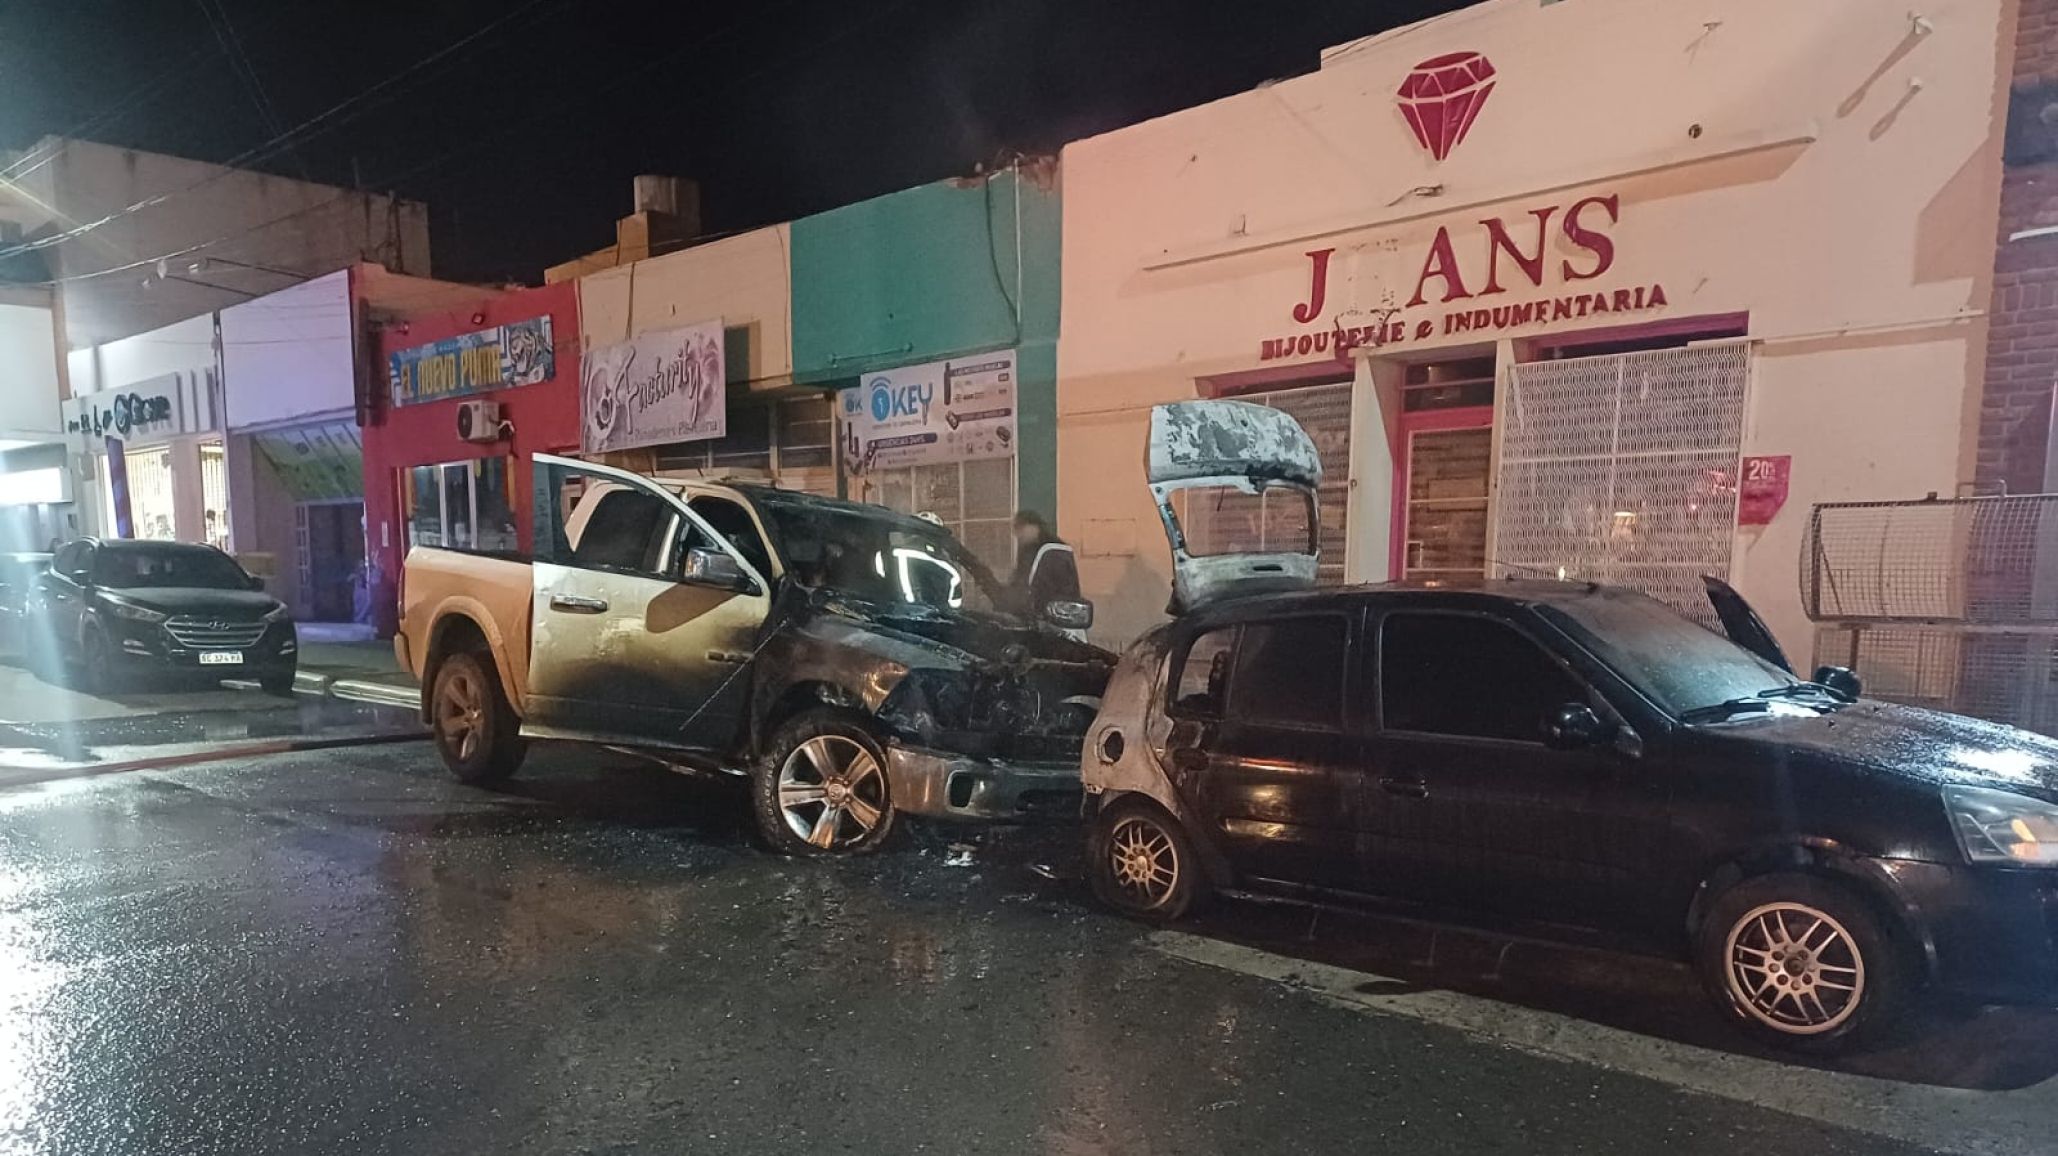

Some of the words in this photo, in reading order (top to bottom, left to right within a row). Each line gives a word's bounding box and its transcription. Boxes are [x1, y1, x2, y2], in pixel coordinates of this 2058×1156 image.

[1293, 193, 1620, 323] JANS
[1445, 284, 1668, 335] INDUMENTARIA
[417, 353, 456, 397] NUEVO
[461, 344, 502, 388] PUMA
